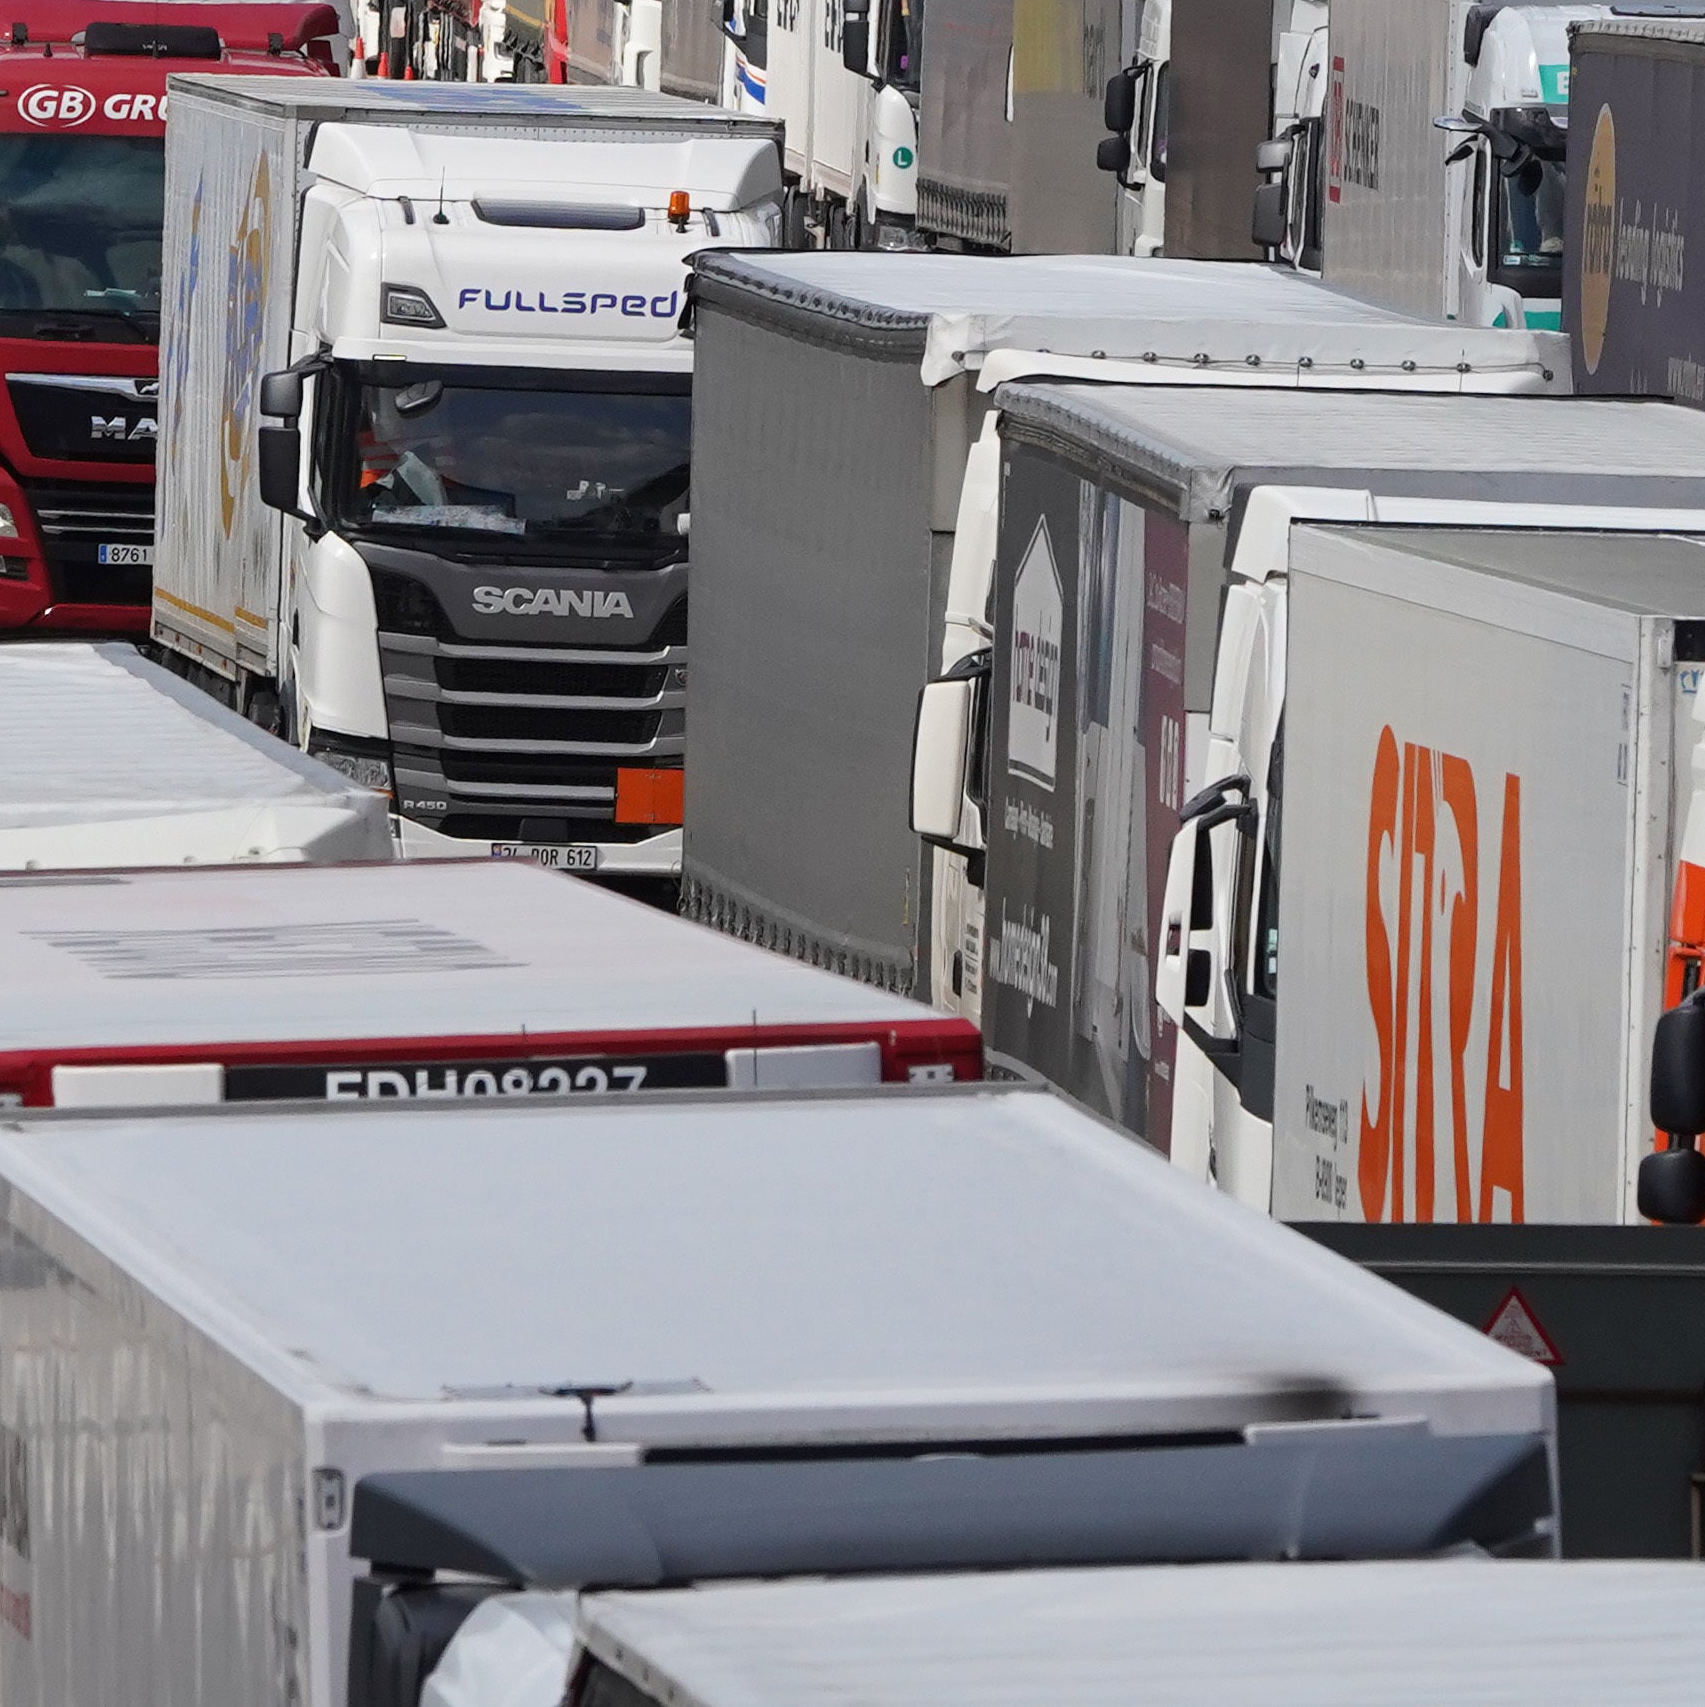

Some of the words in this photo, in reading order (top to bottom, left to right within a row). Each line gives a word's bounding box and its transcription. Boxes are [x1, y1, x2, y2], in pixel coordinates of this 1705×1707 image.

[27, 90, 84, 120] GB
[111, 547, 147, 563] 8761
[472, 585, 635, 619] SCANIA
[403, 800, 415, 810] R
[416, 800, 447, 811] 450
[567, 849, 592, 867] 612
[1358, 724, 1524, 1224] SITRA
